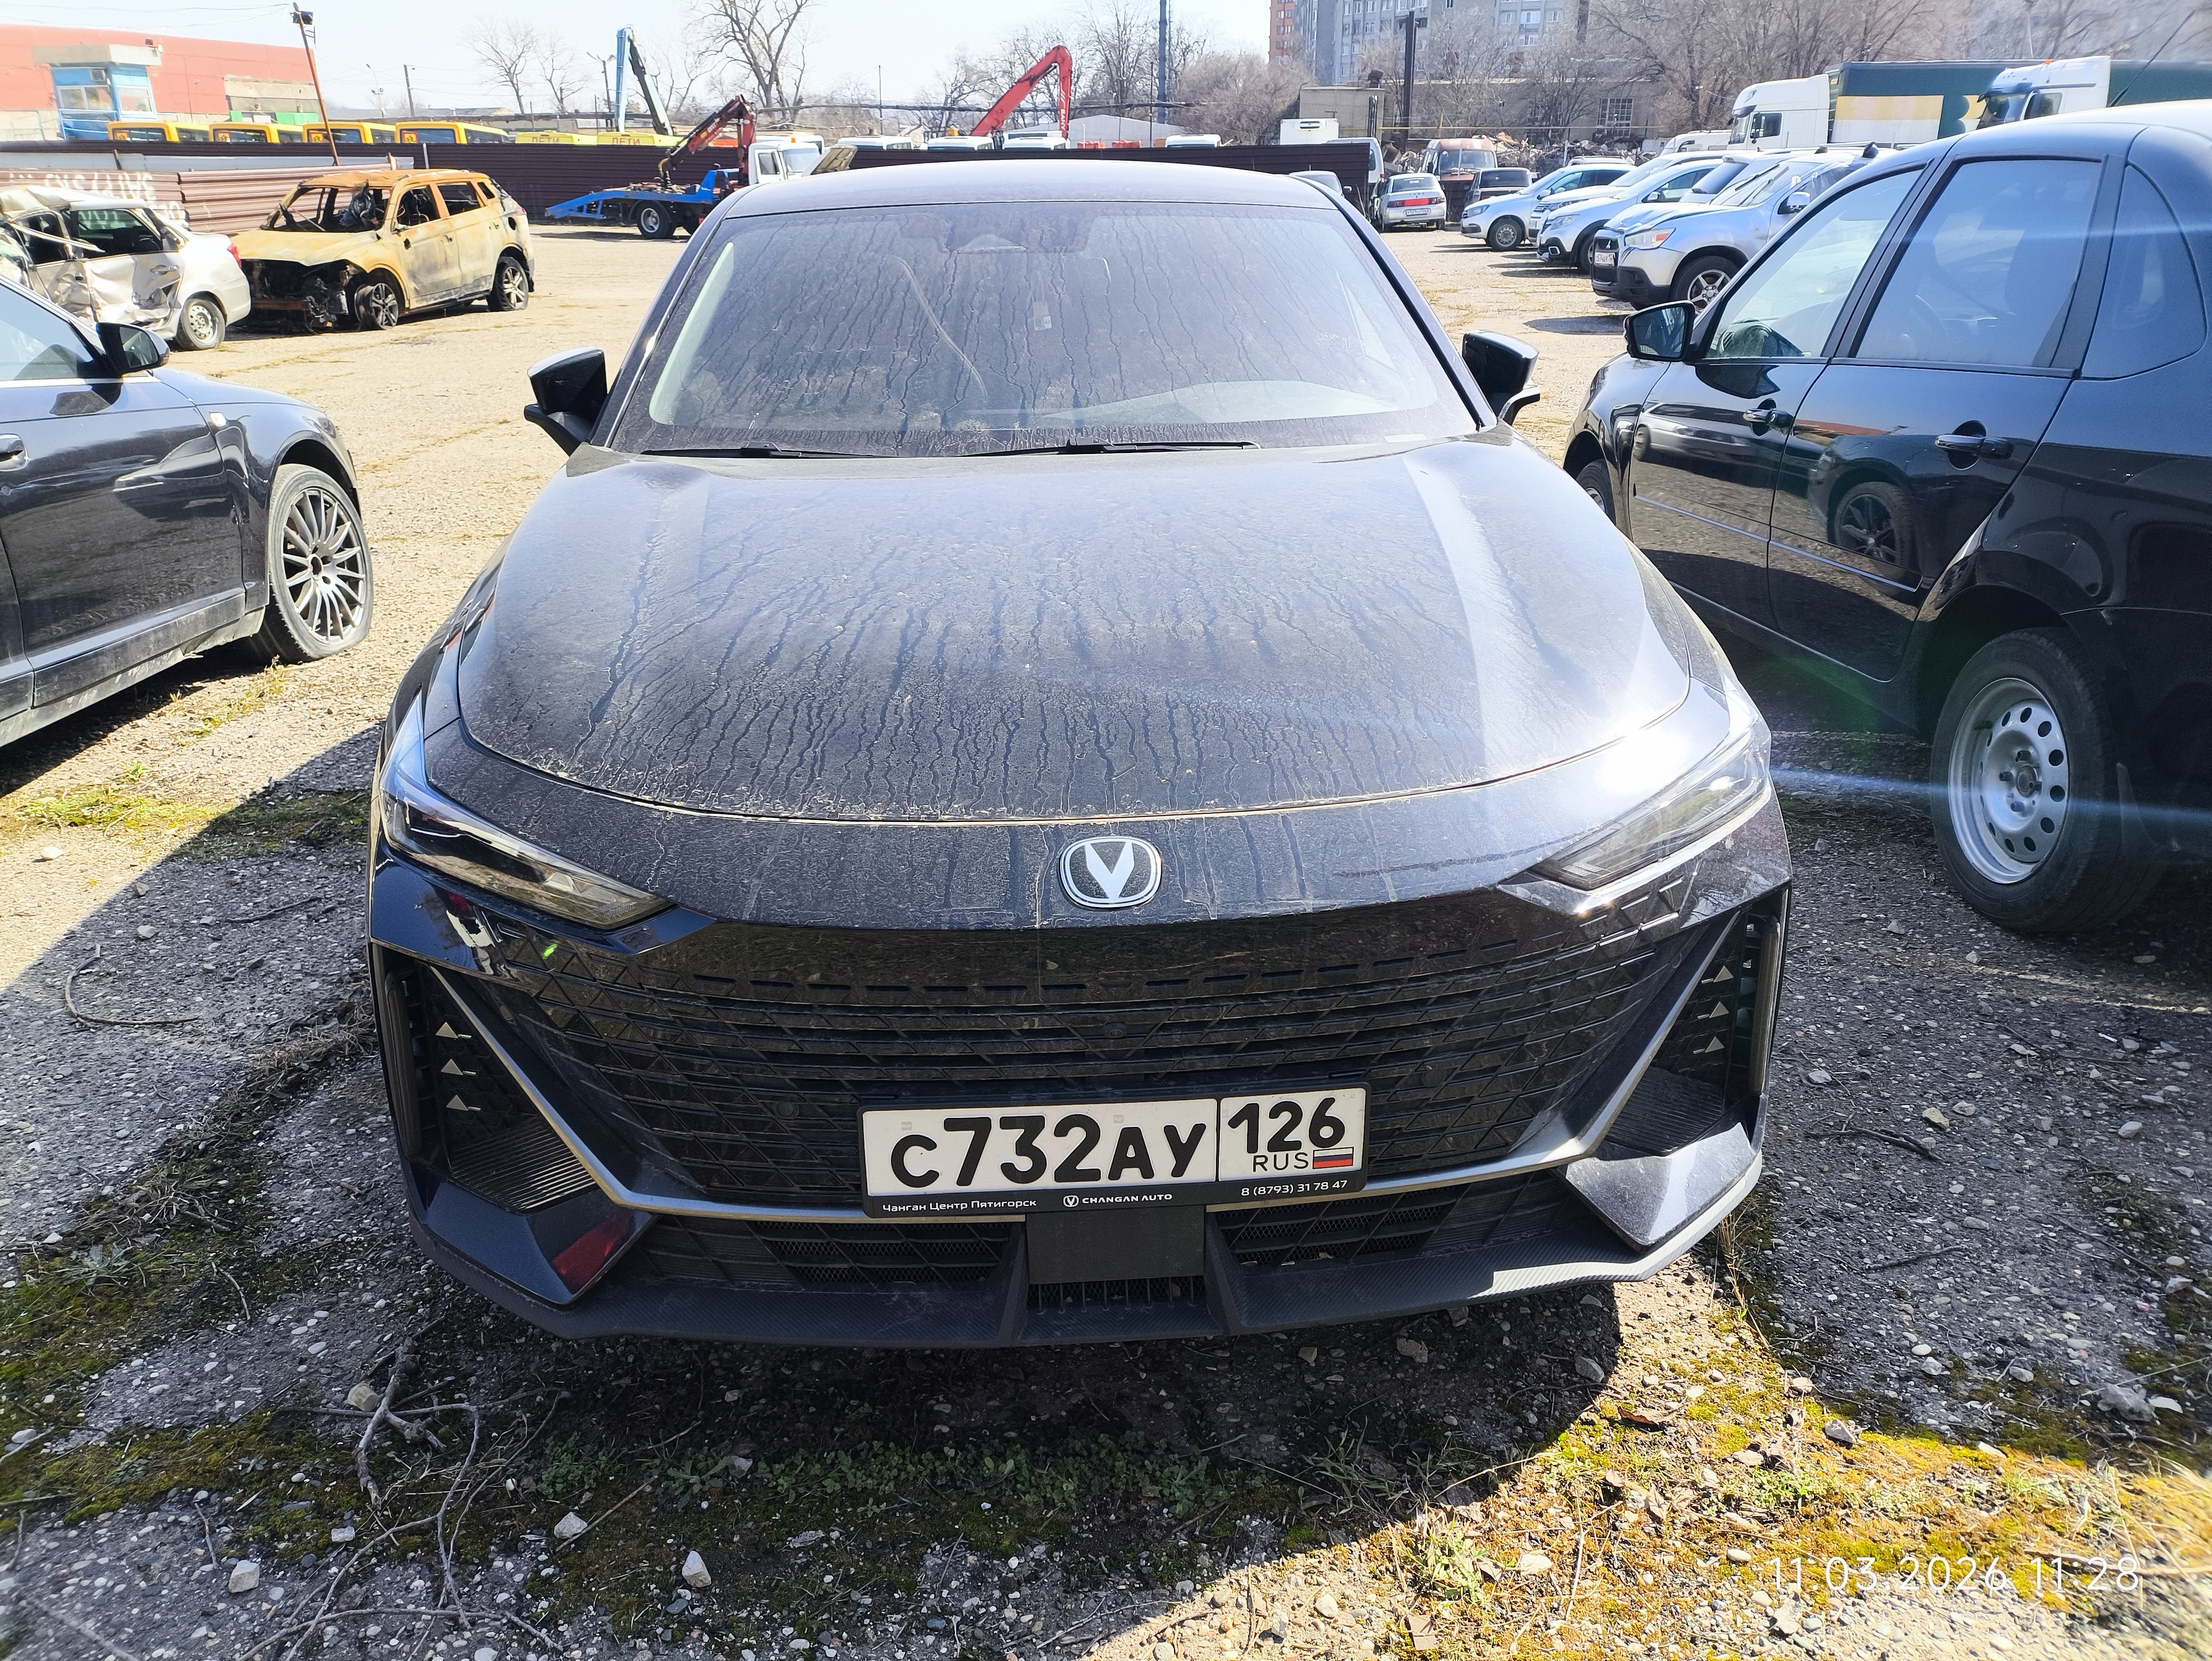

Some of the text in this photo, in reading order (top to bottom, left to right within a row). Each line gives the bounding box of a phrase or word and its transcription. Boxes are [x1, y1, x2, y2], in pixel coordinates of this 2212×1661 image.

[891, 1097, 1346, 1188] С732АУ 126
[1253, 1152, 1309, 1172] RUS
[1241, 1180, 1348, 1196] 8 (8793) 31 78 47
[929, 1202, 968, 1211] Центр
[971, 1200, 1037, 1208] Пятигорск
[1082, 1196, 1139, 1204] CHANGAN
